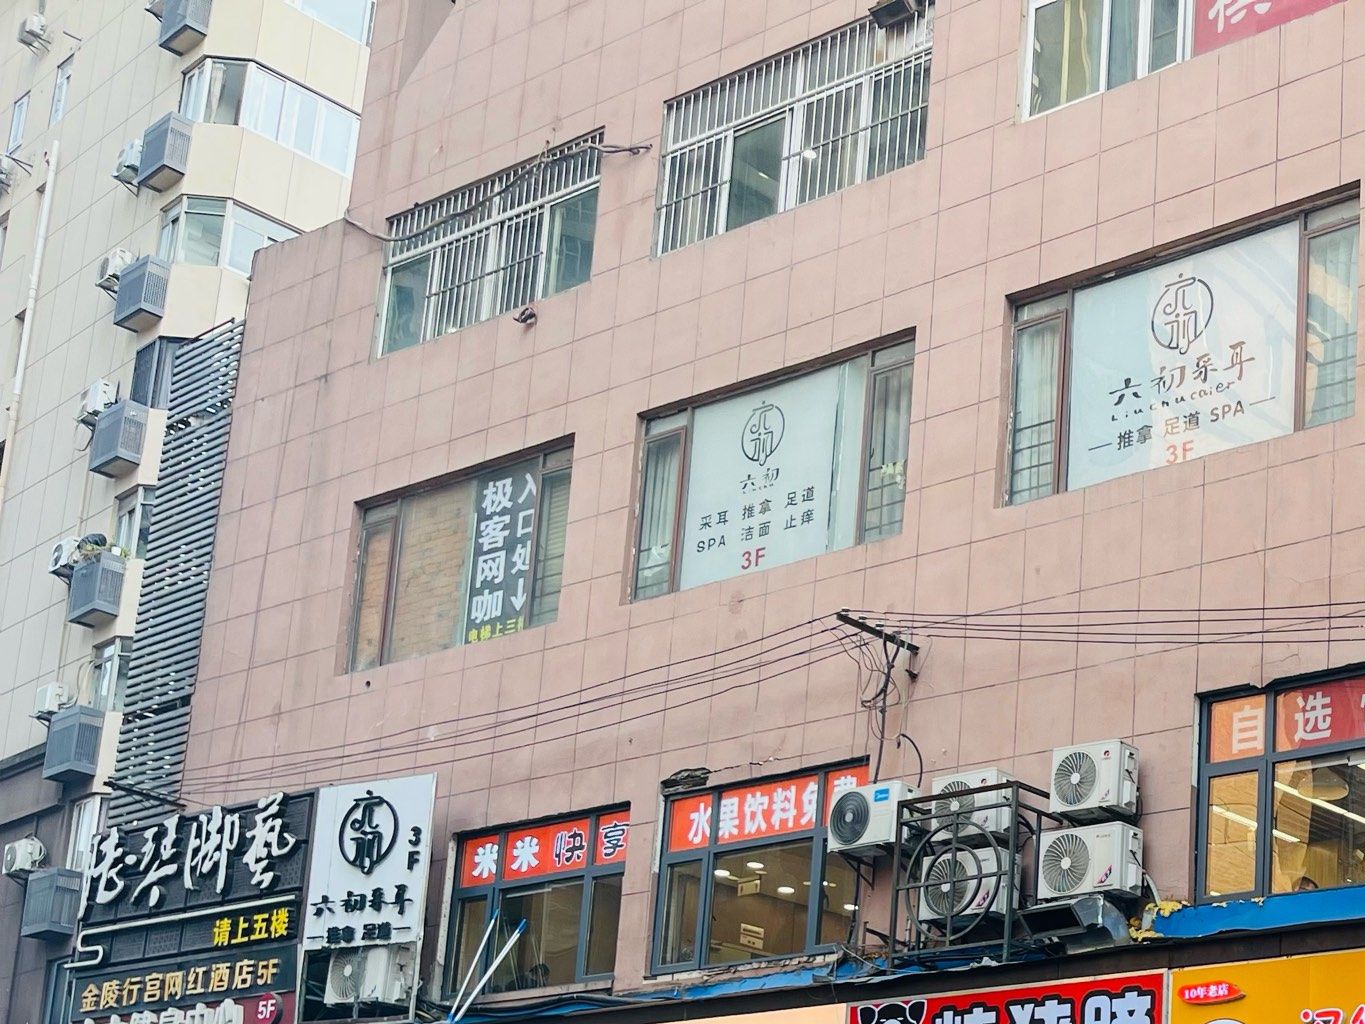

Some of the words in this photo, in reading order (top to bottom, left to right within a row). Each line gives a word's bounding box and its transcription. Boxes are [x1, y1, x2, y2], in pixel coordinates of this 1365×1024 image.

[1109, 341, 1256, 406] 六初采耳
[1117, 425, 1153, 450] 推拿
[1164, 412, 1201, 439] 足道
[1210, 401, 1246, 423] SPA
[1165, 440, 1195, 465] 3F
[510, 473, 537, 575] 入口处
[696, 535, 726, 553] SPA
[741, 522, 770, 542] 洁面
[784, 509, 815, 530] 止痒
[699, 510, 729, 531] 采耳
[742, 499, 772, 521] 推拿
[784, 487, 815, 508] 足道
[471, 477, 513, 624] 极客网咖
[741, 547, 766, 570] 3F
[407, 826, 422, 870] 3F
[213, 907, 290, 946] 请上五楼
[80, 958, 280, 1013] 金陵行宫网红酒店5F
[257, 1000, 276, 1014] 5F
[1184, 983, 1229, 999] 10年老店
